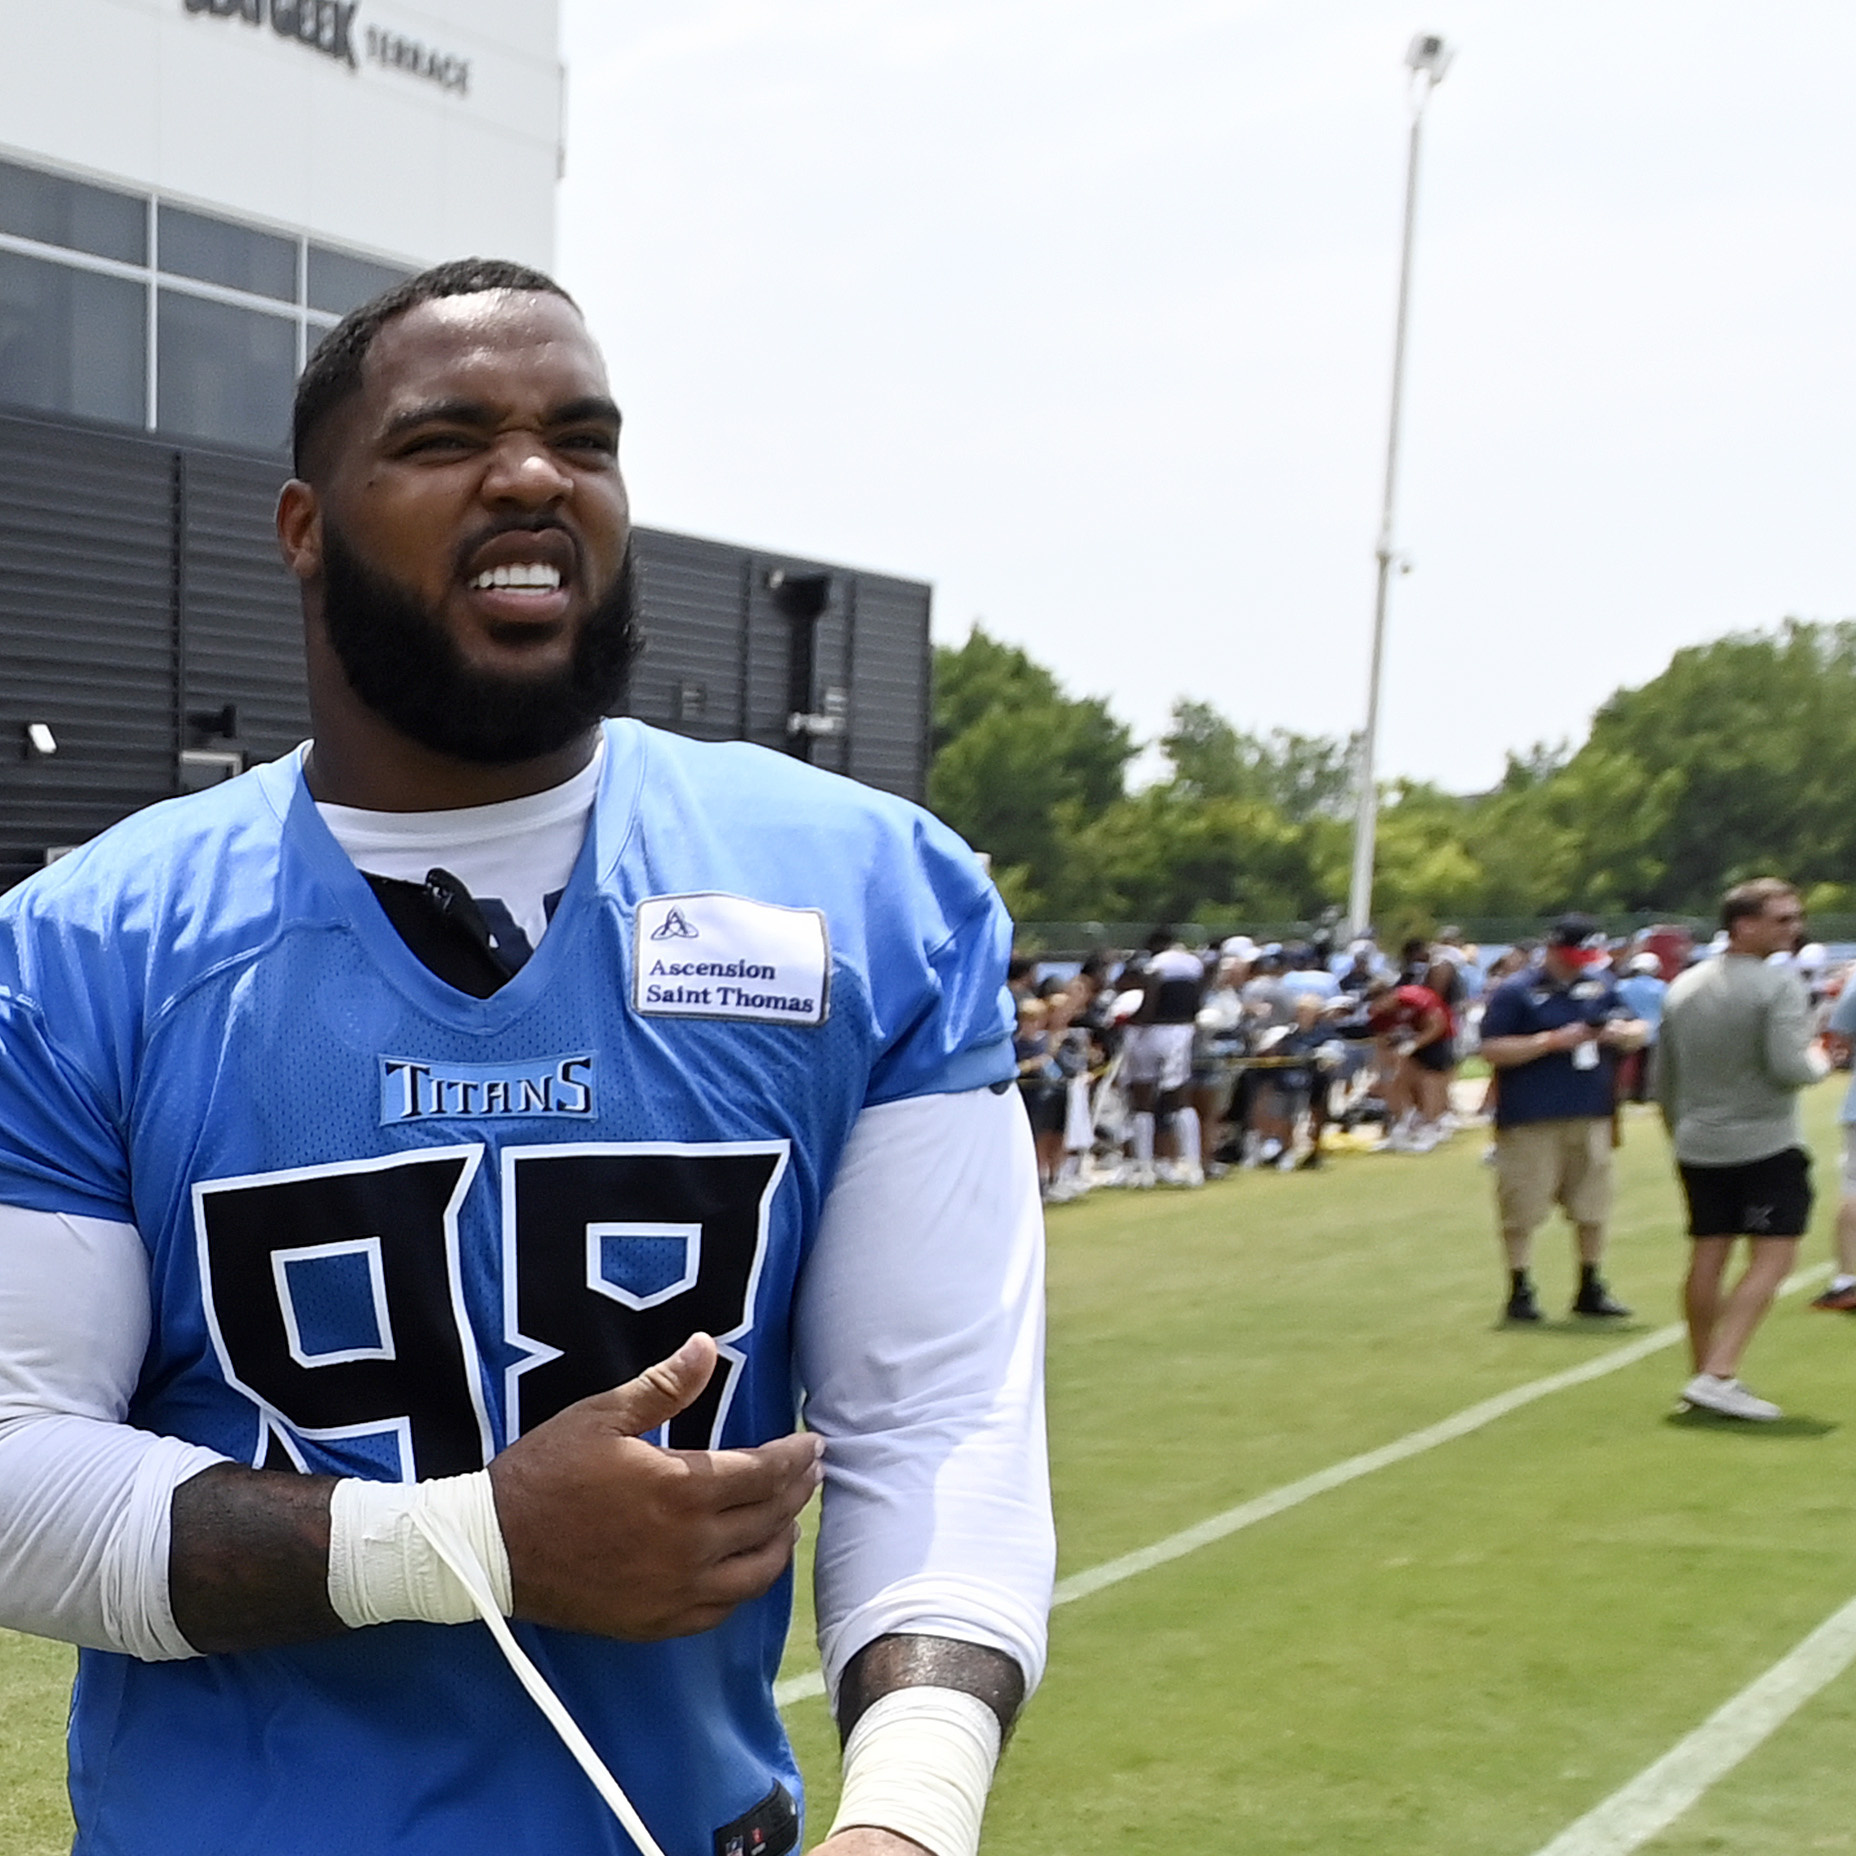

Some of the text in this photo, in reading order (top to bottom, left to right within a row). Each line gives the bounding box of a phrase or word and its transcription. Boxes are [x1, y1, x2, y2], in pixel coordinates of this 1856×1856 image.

[649, 959, 775, 980] Ascension
[646, 984, 814, 1013] Saint Thomas
[192, 1140, 791, 1485] 98
